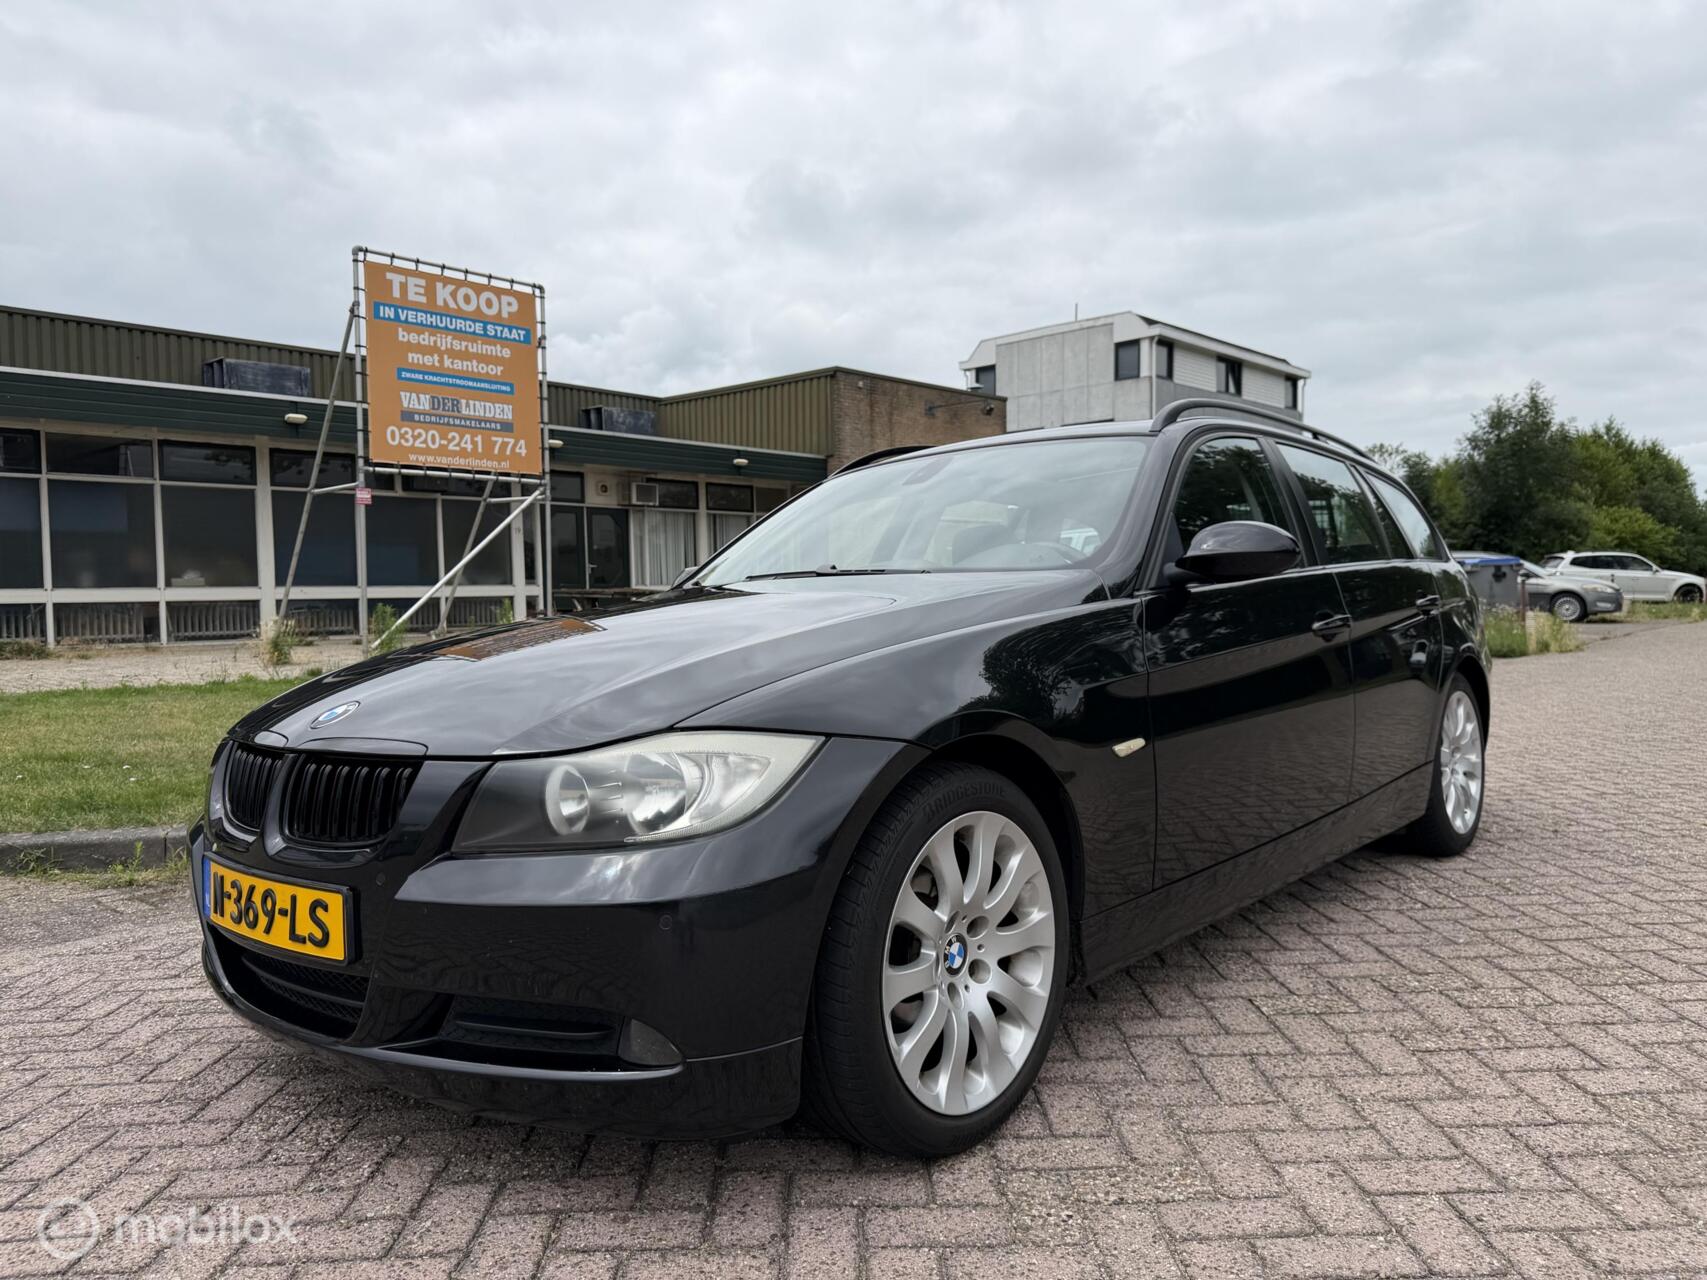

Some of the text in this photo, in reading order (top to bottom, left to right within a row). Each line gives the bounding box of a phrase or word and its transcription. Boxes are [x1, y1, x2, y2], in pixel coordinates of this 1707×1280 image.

[386, 272, 519, 318] TE KOOP
[379, 305, 526, 341] IN VERHUURDE STAAT
[398, 328, 511, 358] bedrijfsruimte
[408, 352, 504, 376] met kantoor
[401, 371, 511, 392] ZWARE KRACHTSTROOMAANSLUITING
[400, 391, 513, 420] VANDERLINDEN
[414, 414, 502, 430] BEDRIJFSMAKELAARS
[386, 425, 527, 457] 0320-241 774
[408, 453, 510, 469] www.vanderlinden.nl
[213, 872, 330, 948] N-369-LS
